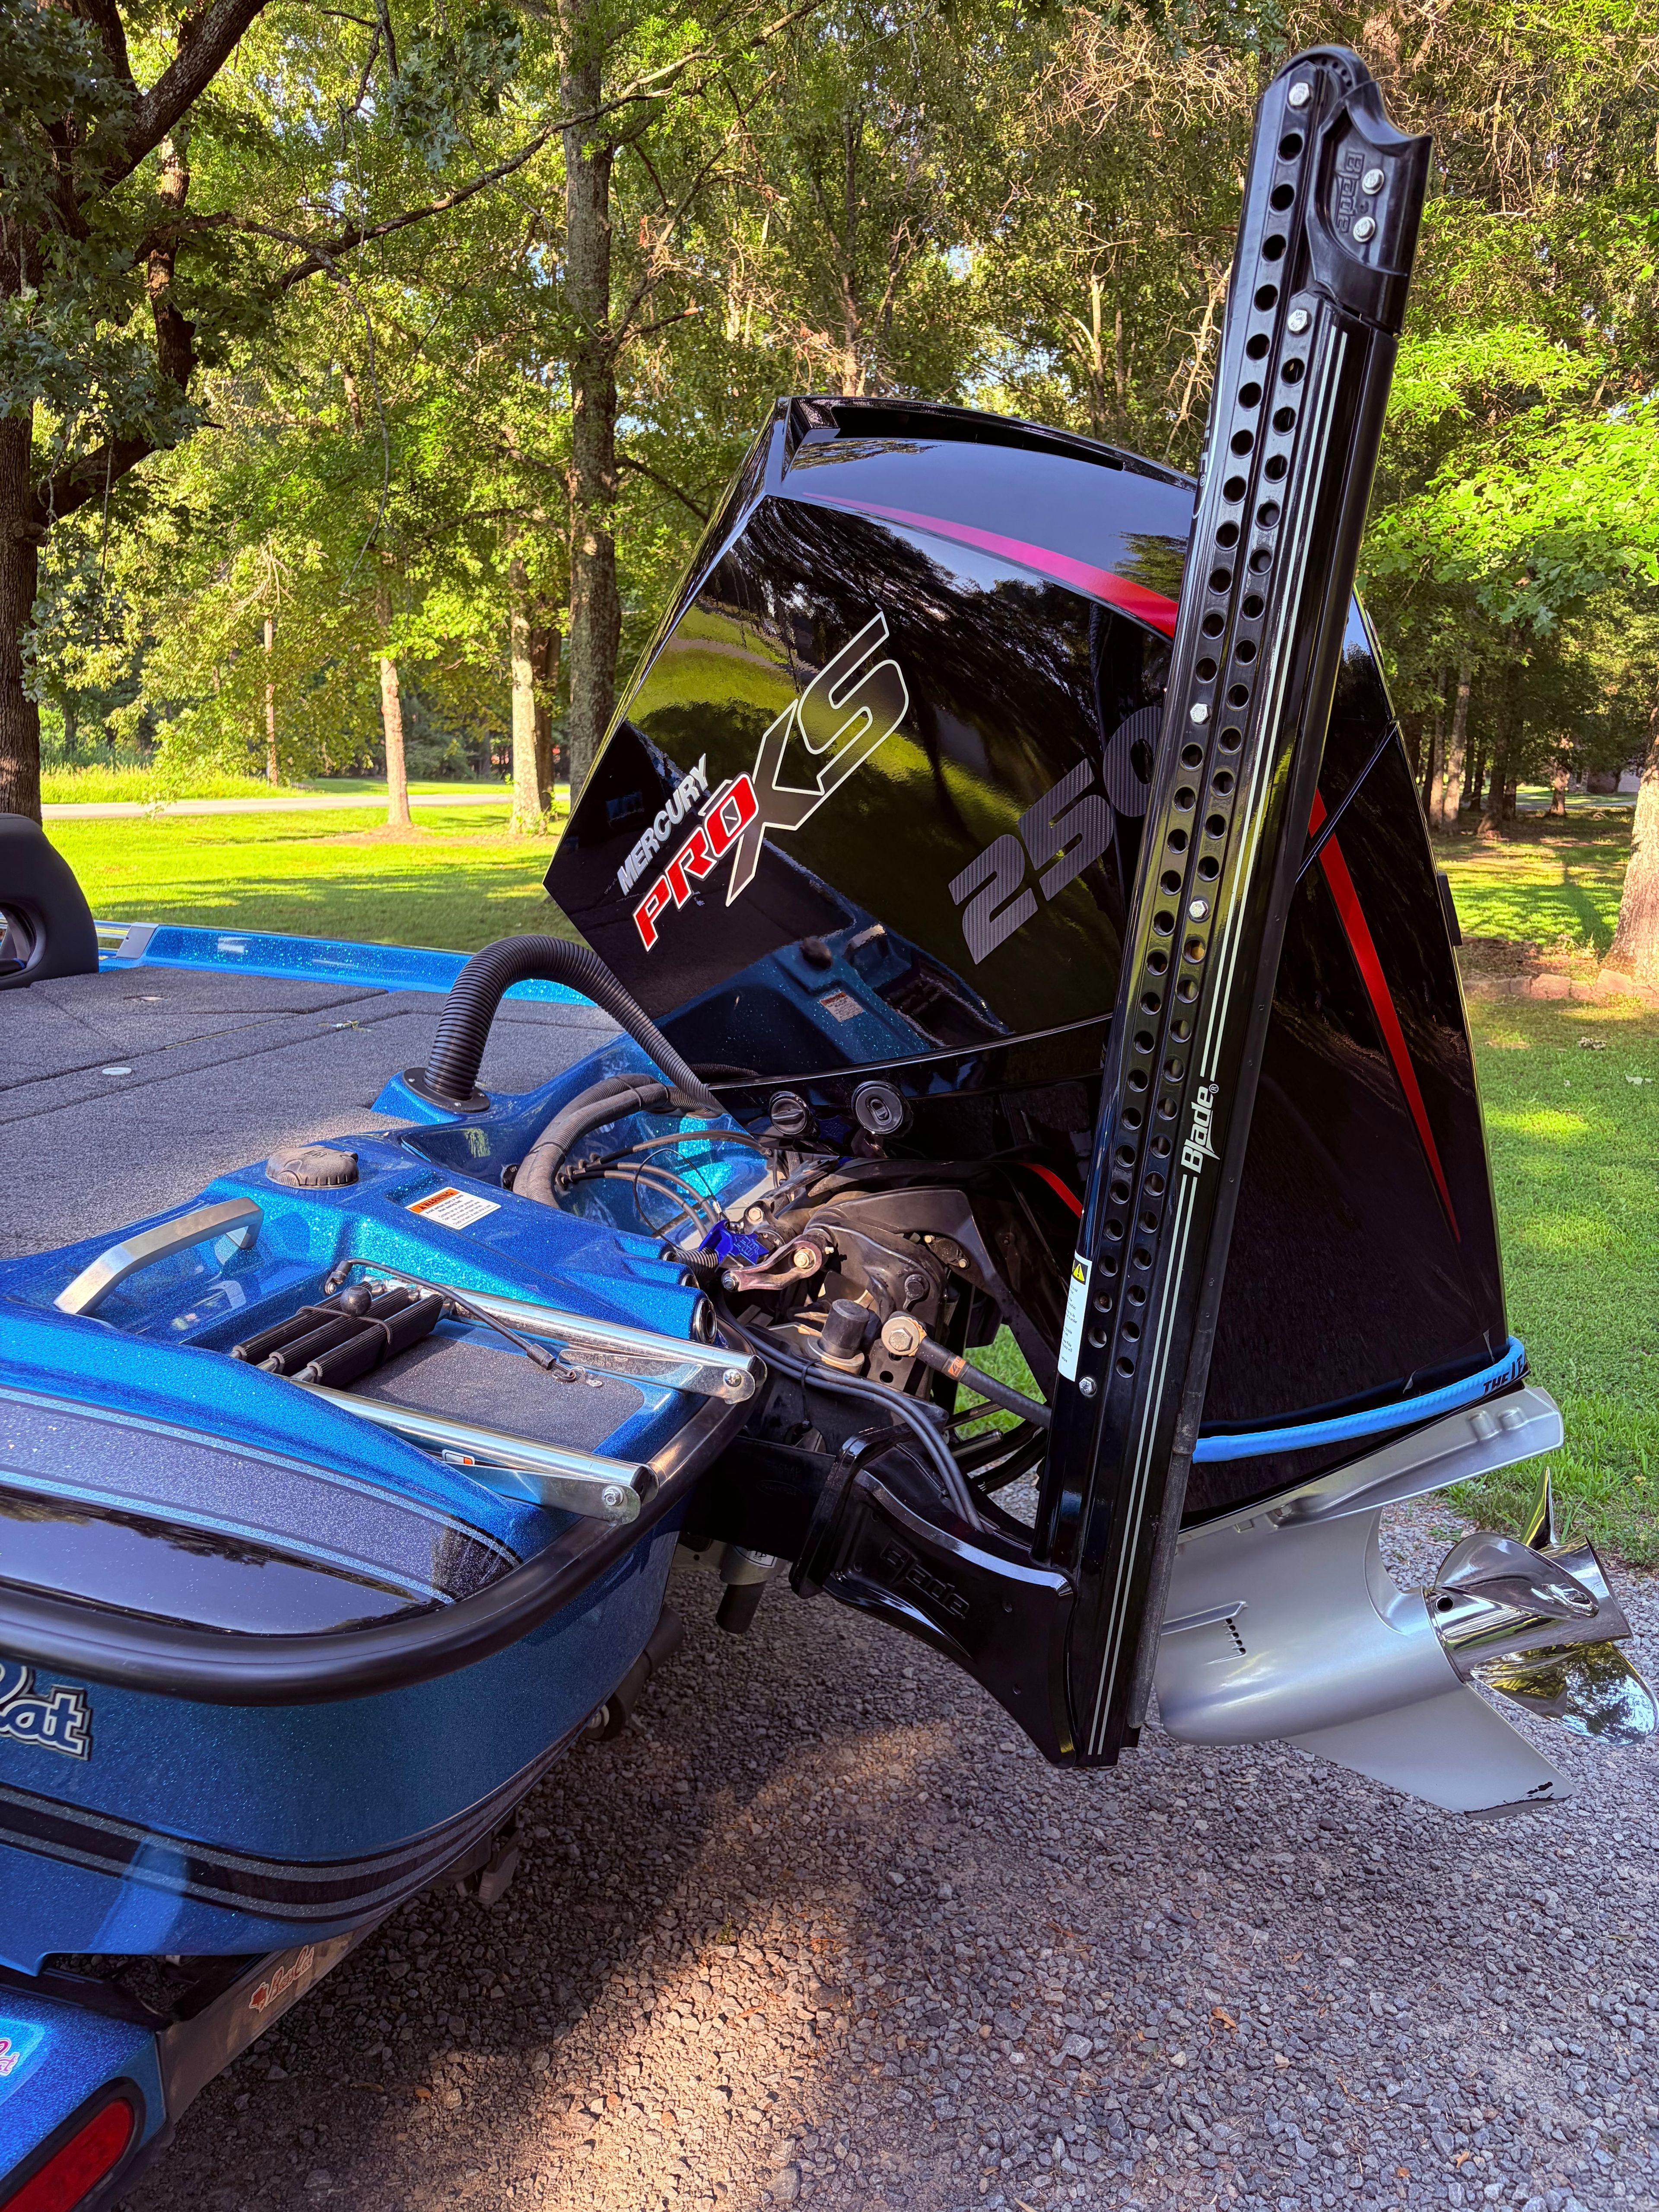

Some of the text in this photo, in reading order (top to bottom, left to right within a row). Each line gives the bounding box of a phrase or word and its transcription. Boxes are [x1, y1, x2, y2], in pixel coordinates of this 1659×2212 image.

[617, 753, 709, 896] MERCURY
[632, 772, 759, 952] PRO
[948, 706, 1163, 965] 250
[421, 1192, 454, 1207] WARNING
[1483, 1371, 1510, 1394] THE
[0, 1665, 89, 1759] at
